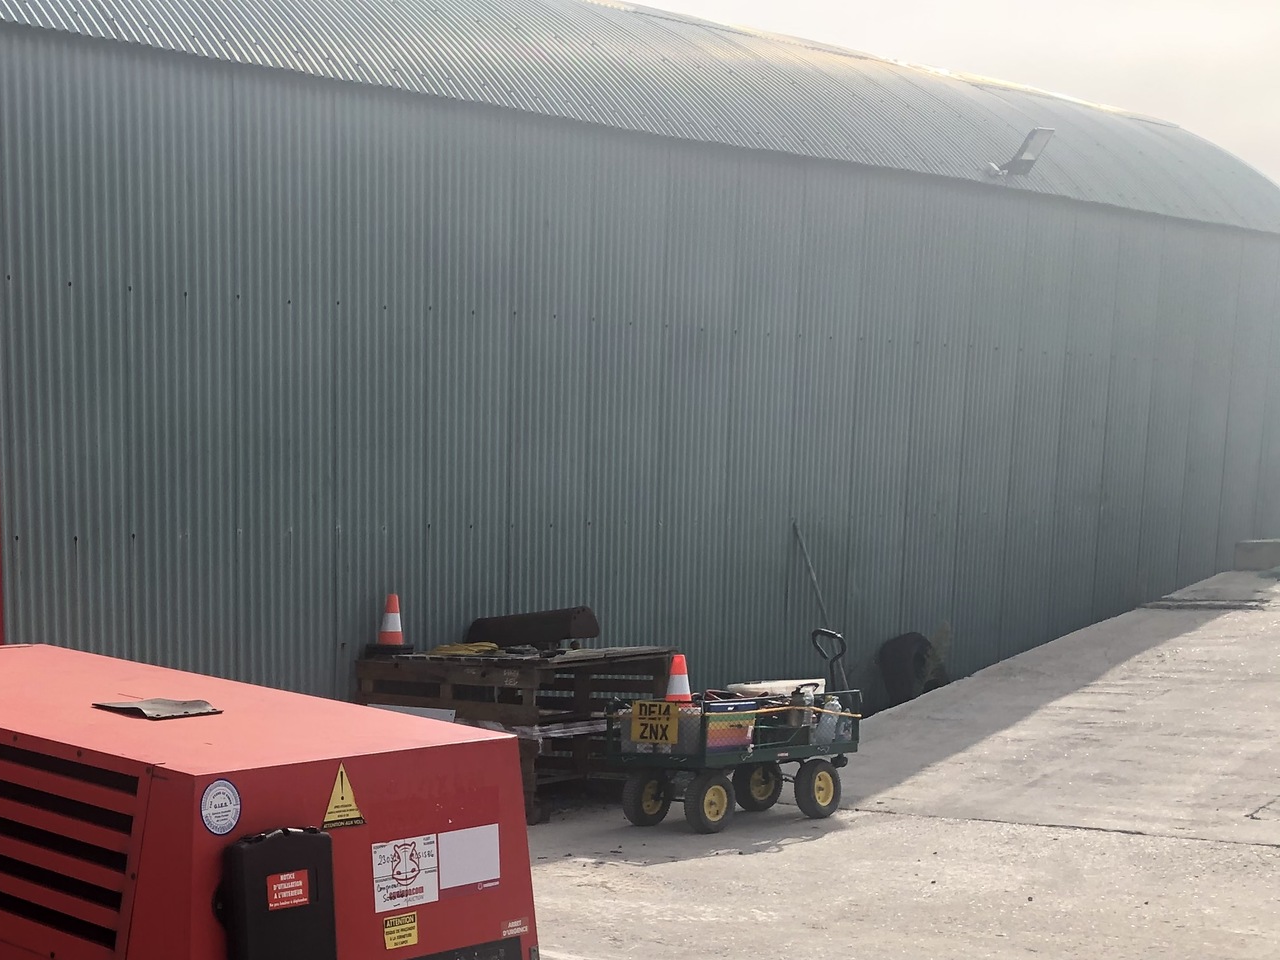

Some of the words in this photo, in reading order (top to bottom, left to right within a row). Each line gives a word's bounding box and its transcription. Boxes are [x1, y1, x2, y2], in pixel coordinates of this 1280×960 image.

[638, 703, 670, 721] DE14
[640, 723, 669, 740] ZNX
[386, 915, 415, 927] ATTENTION
